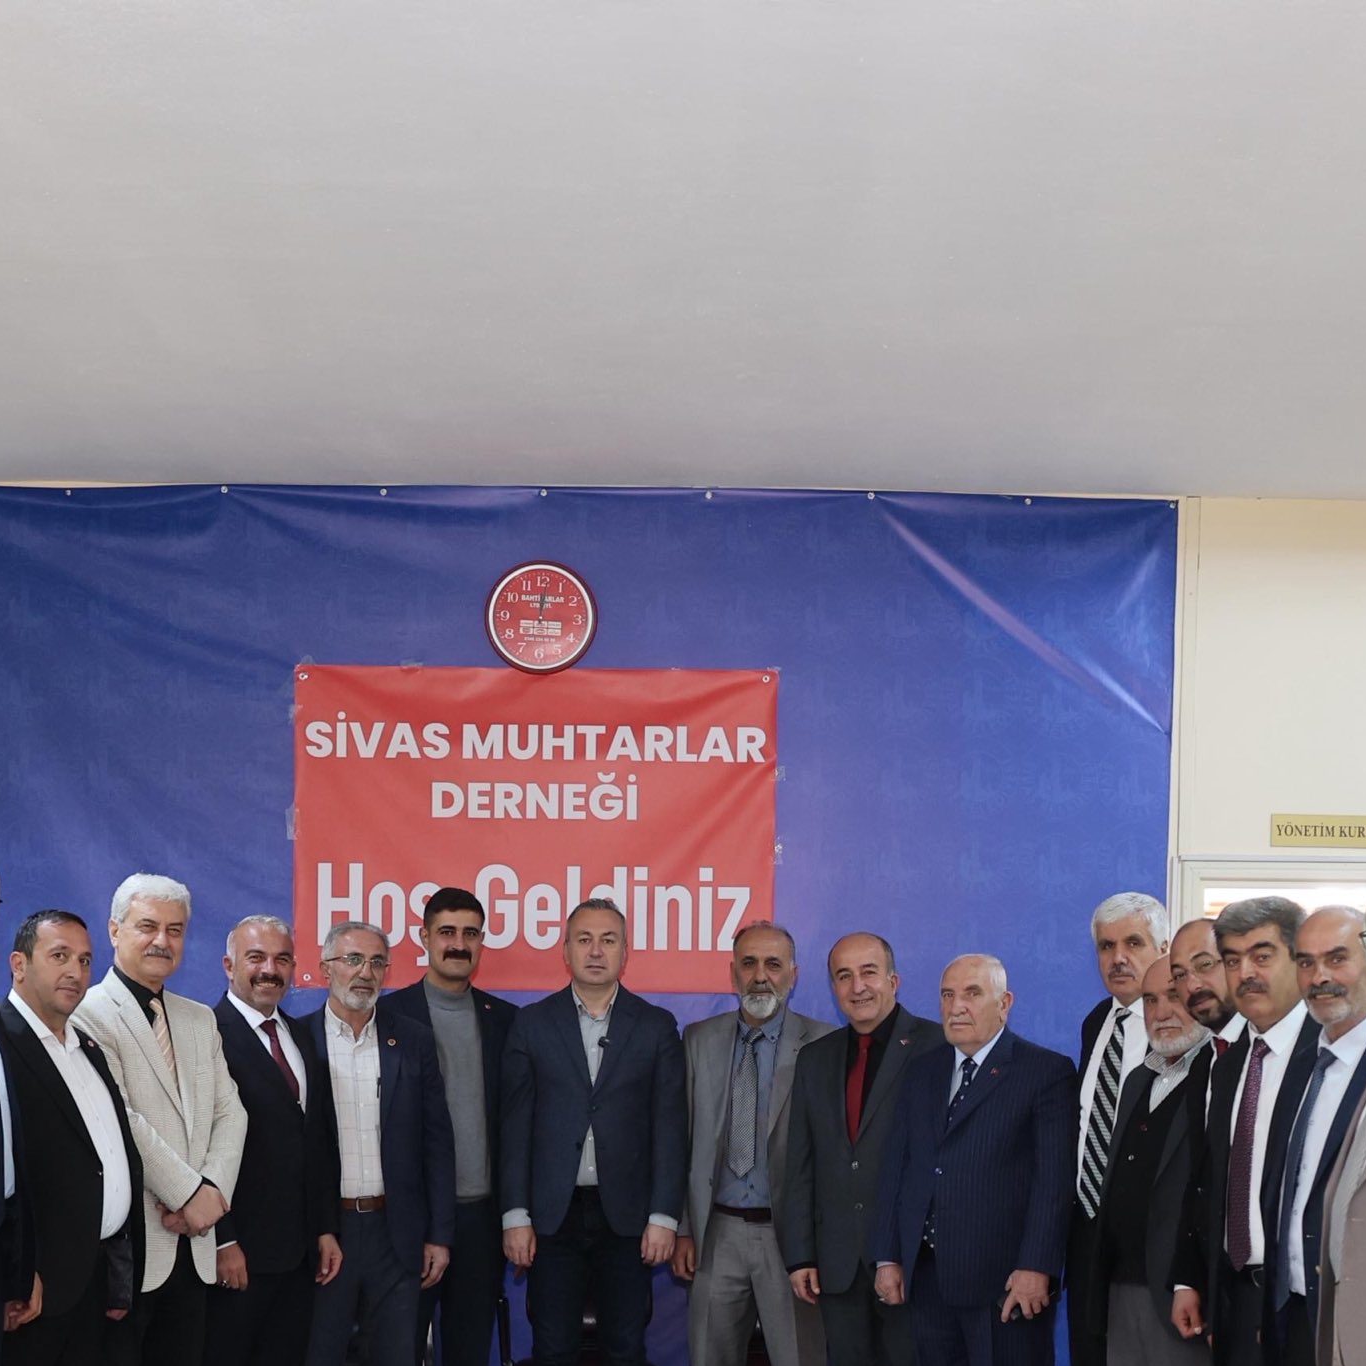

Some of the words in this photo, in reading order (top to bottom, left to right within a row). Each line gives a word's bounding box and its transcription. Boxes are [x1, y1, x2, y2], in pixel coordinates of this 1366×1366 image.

[521, 580, 531, 591] 11
[536, 576, 550, 588] 12
[558, 582, 563, 593] 1
[507, 592, 519, 603] 10
[568, 596, 577, 607] 2
[500, 610, 510, 621] 9
[572, 614, 582, 625] 3
[505, 628, 514, 639] 8
[566, 632, 575, 643] 4
[517, 642, 526, 653] 7
[552, 644, 561, 656] 5
[534, 648, 544, 659] 6
[305, 711, 451, 759] SİVAS
[462, 723, 767, 763] MUHTARLAR
[431, 771, 638, 821] DERNEĞİ
[1276, 821, 1335, 838] YÖNETİM
